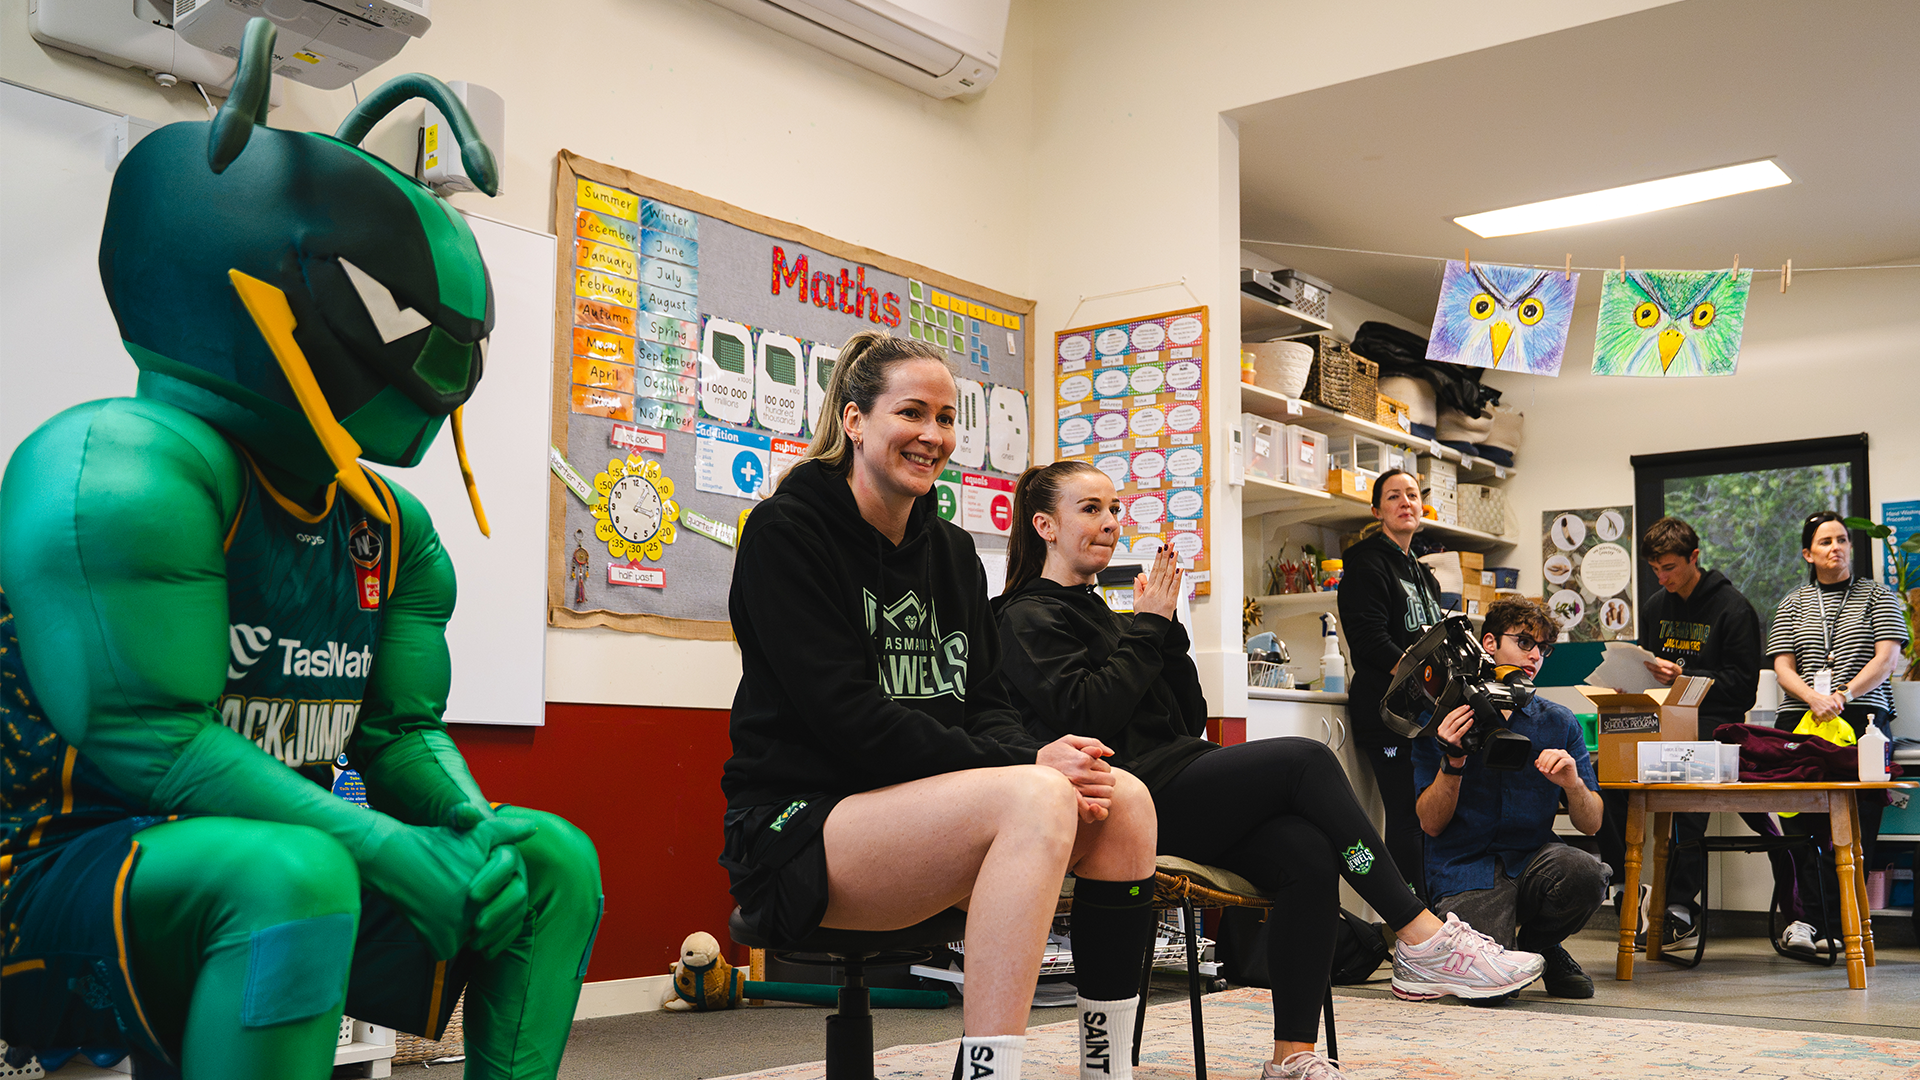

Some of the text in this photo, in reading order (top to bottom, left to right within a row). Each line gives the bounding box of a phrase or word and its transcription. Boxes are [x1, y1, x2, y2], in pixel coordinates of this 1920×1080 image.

[584, 185, 632, 210] Summer
[649, 206, 689, 227] Winter
[579, 217, 636, 244] December
[655, 240, 685, 258] June
[583, 246, 633, 275] January
[656, 266, 682, 288] July
[580, 275, 633, 303] February
[771, 245, 902, 328] Maths
[648, 293, 687, 313] August
[583, 304, 629, 324] Autumn
[650, 321, 687, 345] Spring
[586, 336, 624, 354] March
[639, 348, 695, 369] September
[590, 366, 619, 383] April
[644, 375, 690, 394] Ocber
[712, 384, 728, 396] 000
[731, 388, 748, 400] 000
[592, 393, 616, 415] My
[714, 397, 739, 409] millions
[765, 395, 795, 409] 100 000
[639, 407, 692, 427] Nomber
[765, 405, 794, 418] hundred
[762, 412, 796, 426] thousands
[700, 427, 739, 443] addition
[963, 435, 969, 444] 10
[1001, 452, 1014, 461] ones
[612, 468, 625, 477] :55
[645, 470, 658, 479] :05
[576, 481, 586, 493] to
[600, 482, 613, 490] :50
[621, 482, 627, 490] 11
[632, 479, 639, 487] 12
[965, 476, 988, 486] equals
[614, 491, 621, 499] 10
[658, 485, 669, 494] :10
[594, 504, 608, 512] :45
[615, 515, 620, 524] 8
[687, 516, 714, 532] quarter
[600, 524, 614, 533] :40
[623, 526, 628, 534] 7
[643, 529, 648, 538] 5
[660, 527, 671, 537] :20
[633, 532, 638, 540] 6
[612, 539, 624, 548] :35
[628, 544, 641, 553] :30
[646, 543, 658, 552] :25
[618, 570, 654, 583] half past
[885, 637, 936, 652] ASMANIA
[278, 638, 373, 678] TasNat
[882, 637, 968, 697] WELS
[1604, 719, 1659, 730] SCHOOLS PROGRAM
[221, 698, 362, 768] ACKJUMP
[1083, 1011, 1110, 1075] SAINT
